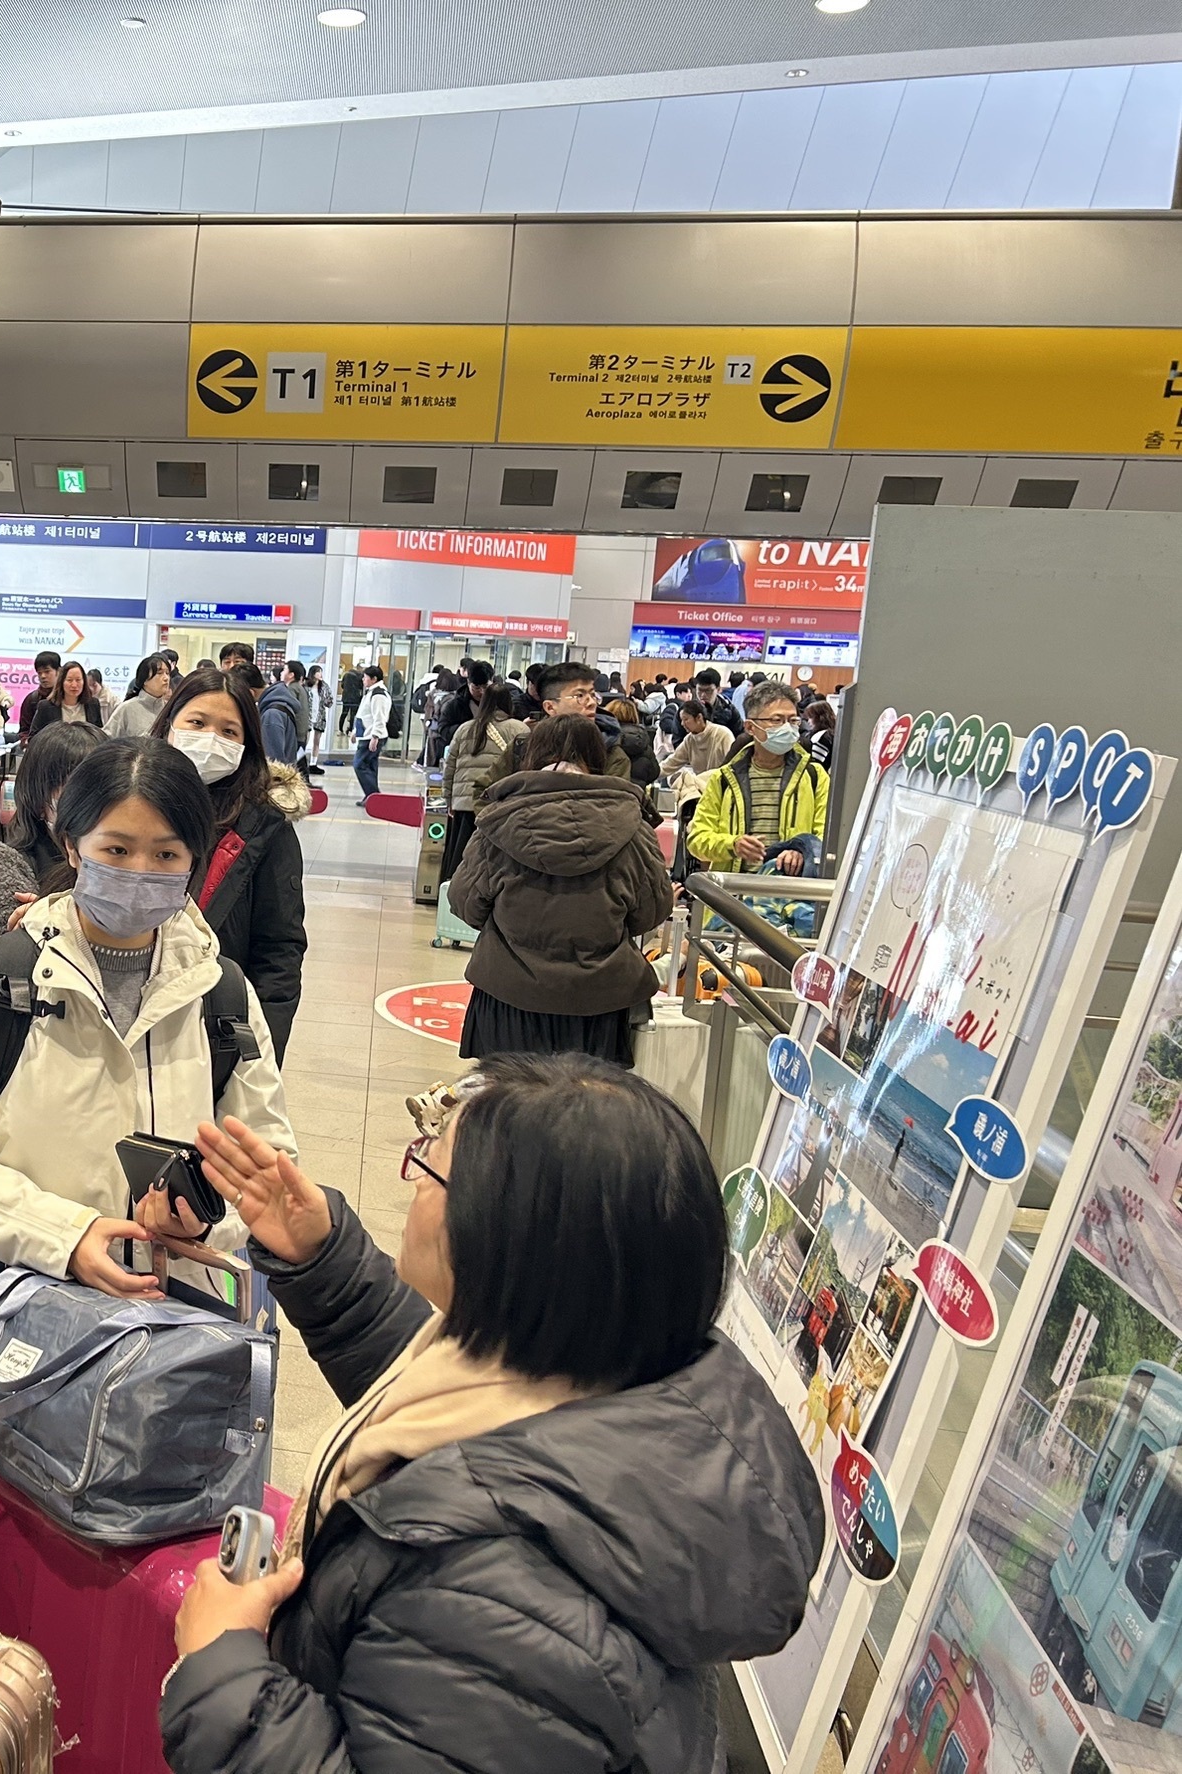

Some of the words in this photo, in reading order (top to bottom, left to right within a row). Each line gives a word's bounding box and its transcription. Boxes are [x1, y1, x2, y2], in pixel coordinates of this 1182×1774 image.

[335, 359, 477, 379] 第1ターミナル
[588, 354, 715, 371] 第2ターミナル
[727, 362, 752, 378] T2
[272, 368, 317, 399] T1
[549, 372, 599, 383] Terminal
[601, 373, 609, 382] 2
[335, 380, 397, 393] Terminal
[401, 381, 409, 393] 1
[358, 396, 392, 406] 터미널
[599, 392, 711, 407] エアロプラザ
[585, 408, 642, 419] Aeroplaza
[44, 525, 101, 540] 제1터미널
[185, 530, 247, 544] 2号航站楼
[255, 532, 315, 546] 제2터미널
[396, 530, 446, 552] TICKET
[449, 533, 548, 562] INFORMATION
[757, 540, 791, 566] to
[677, 610, 710, 621] Ticket
[712, 611, 743, 622] Office
[34, 636, 65, 646] NANKAI
[848, 1459, 886, 1523] めでたい
[842, 1493, 874, 1559] でんしゃ
